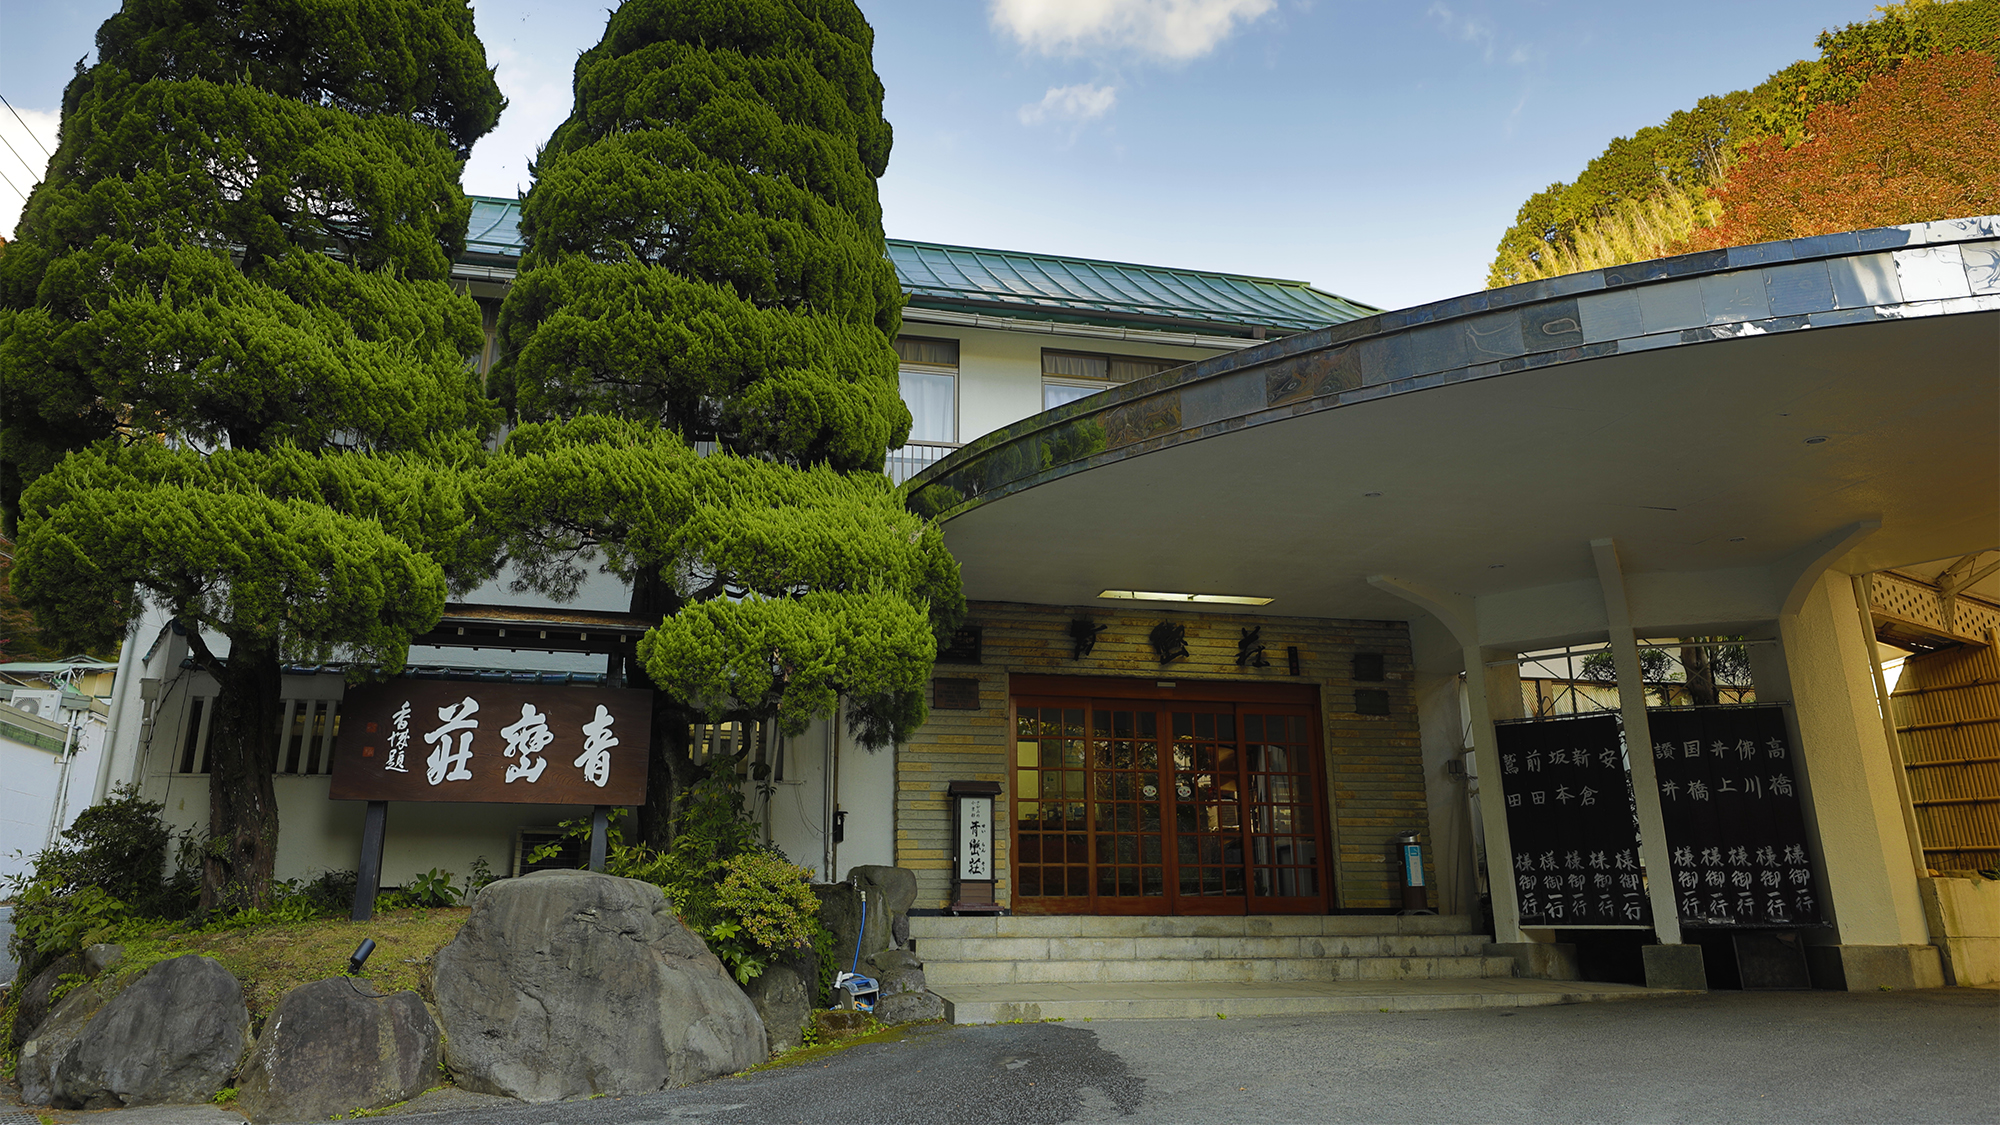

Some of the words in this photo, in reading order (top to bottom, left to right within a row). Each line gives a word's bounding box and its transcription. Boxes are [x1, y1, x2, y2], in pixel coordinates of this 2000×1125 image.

[1525, 749, 1546, 805] 前田
[1548, 748, 1575, 806] 坂本
[1571, 747, 1599, 807] 新倉
[1598, 747, 1619, 770] 安
[1682, 739, 1710, 802] 国橋
[1709, 739, 1738, 793] 井上
[1765, 736, 1793, 798] 高橋
